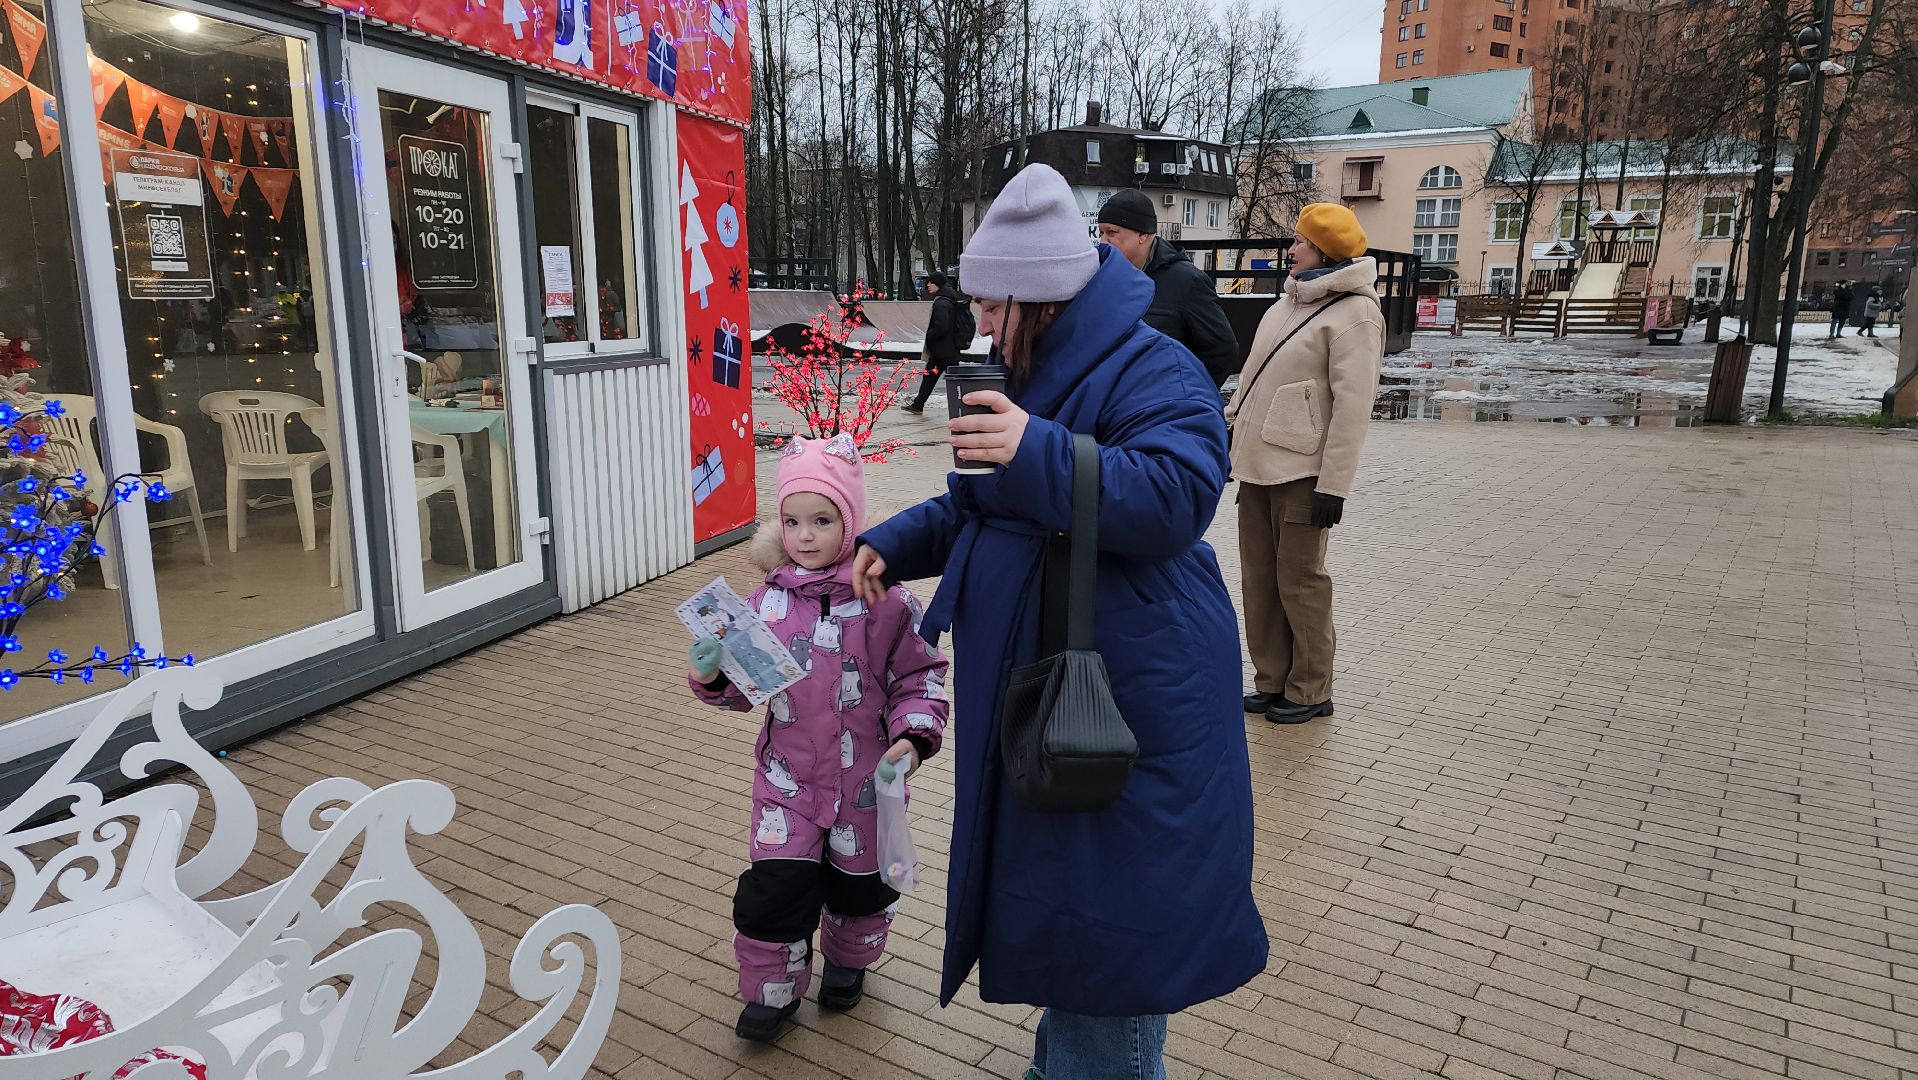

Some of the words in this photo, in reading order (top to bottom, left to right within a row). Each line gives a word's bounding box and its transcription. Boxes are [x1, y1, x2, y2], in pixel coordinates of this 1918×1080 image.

[409, 146, 459, 179] ПРОКАТ
[413, 187, 438, 198] РЕЖИМ
[438, 190, 462, 200] РАБОТЫ
[415, 204, 464, 225] 10-20
[418, 231, 465, 250] 10-21
